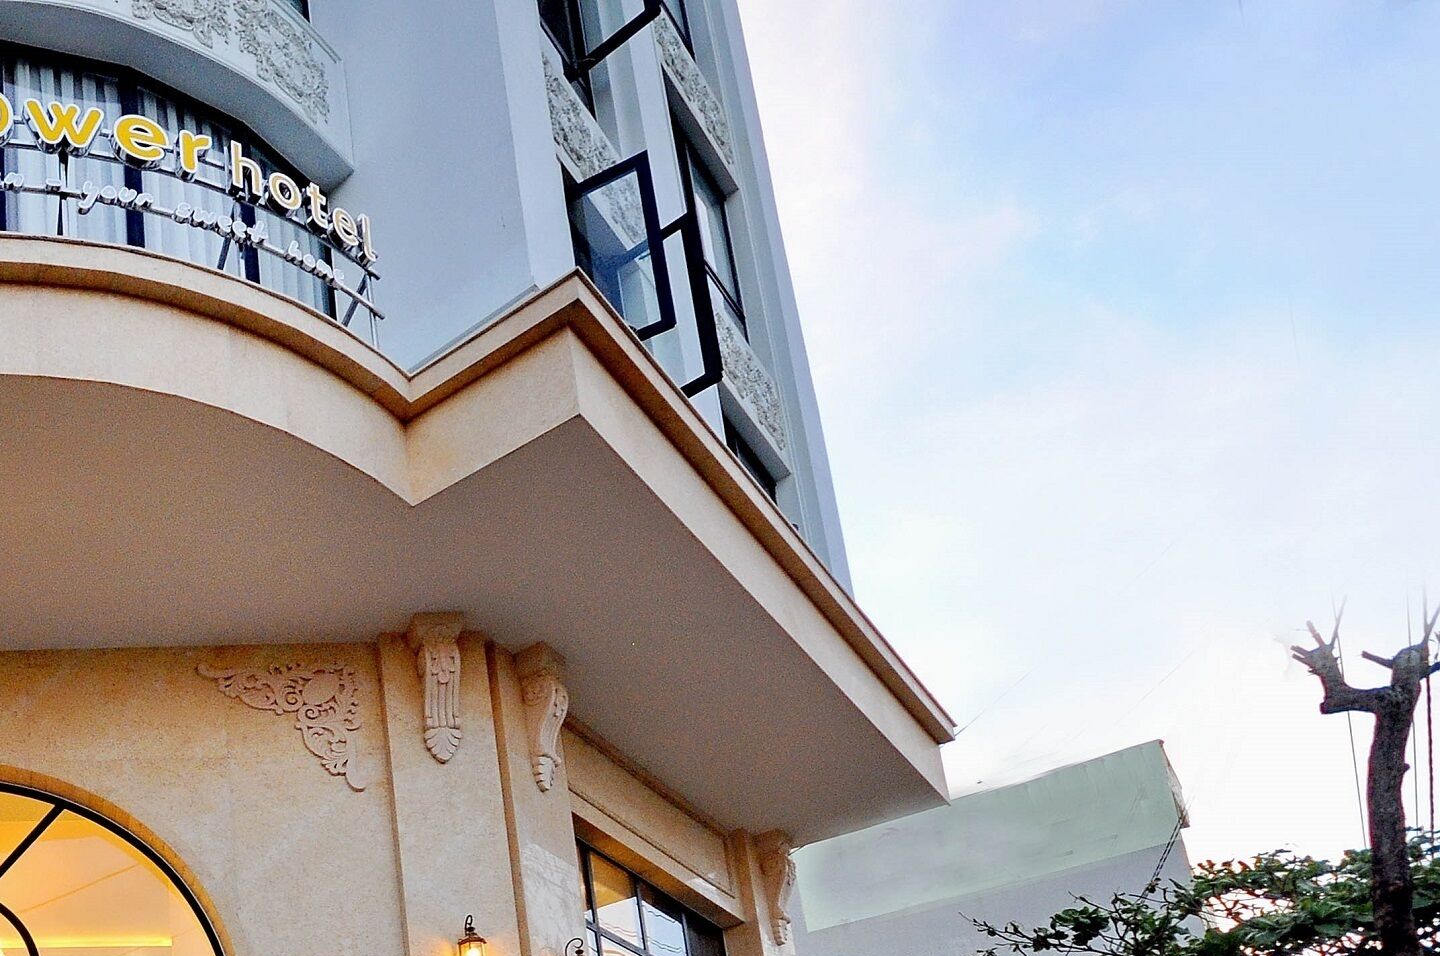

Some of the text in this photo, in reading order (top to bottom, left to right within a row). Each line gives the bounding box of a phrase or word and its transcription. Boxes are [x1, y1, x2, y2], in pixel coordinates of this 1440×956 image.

[77, 180, 155, 211] your
[175, 202, 270, 243] sweet
[287, 241, 346, 285] home
[230, 139, 378, 263] hotel
